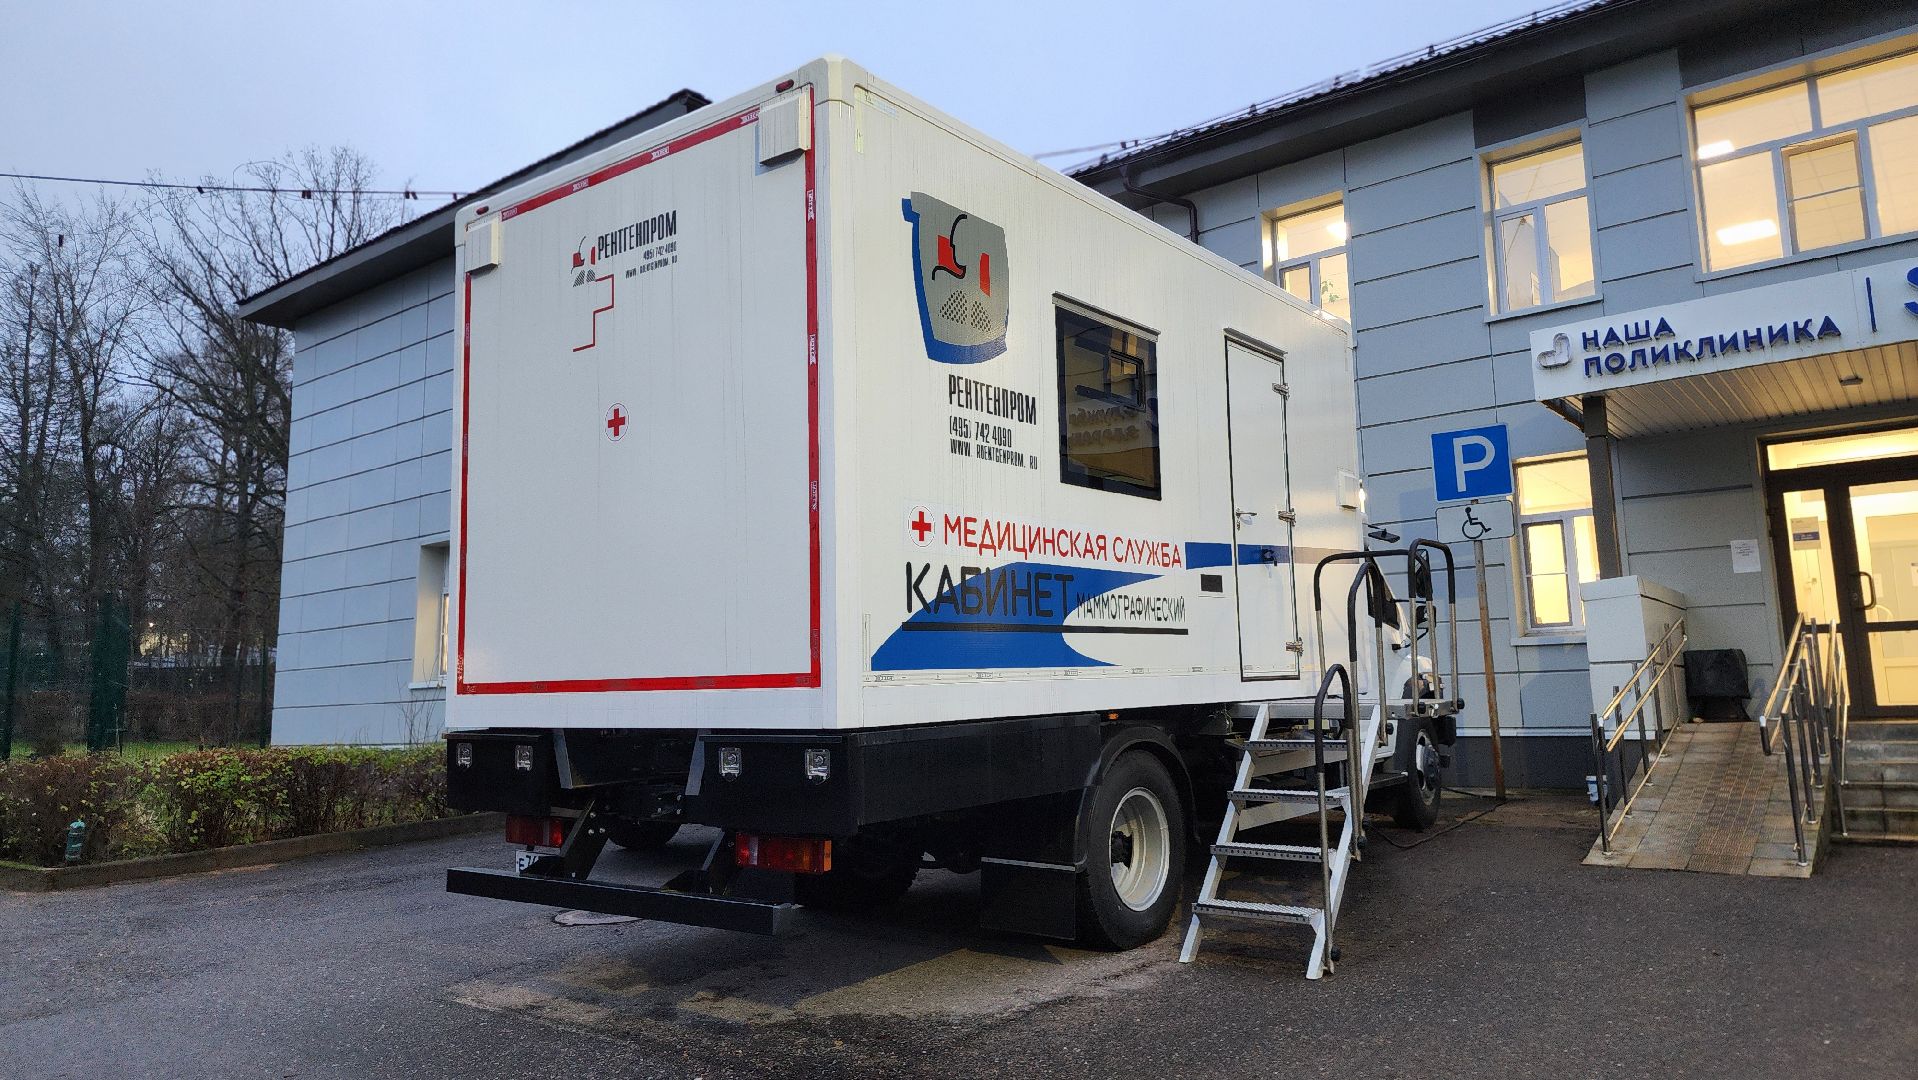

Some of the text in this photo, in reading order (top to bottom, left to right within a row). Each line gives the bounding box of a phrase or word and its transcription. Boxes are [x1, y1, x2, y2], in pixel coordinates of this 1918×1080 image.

[598, 210, 676, 260] РЕНТГЕНПРОМ
[1582, 317, 1676, 351] НАША
[1584, 316, 1842, 378] ПОЛИКЛИНИКА
[949, 374, 1037, 426] РЕНТГЕНПРОМ
[949, 415, 1012, 448] (495) 742 4090
[1453, 435, 1496, 493] P
[944, 513, 1182, 568] МЕДИЦИНСКАЯ СЛУЖБА
[906, 561, 1074, 618] КАБИНЕТ
[1076, 591, 1186, 623] МАММОГРАФИЧЕСКИЙ
